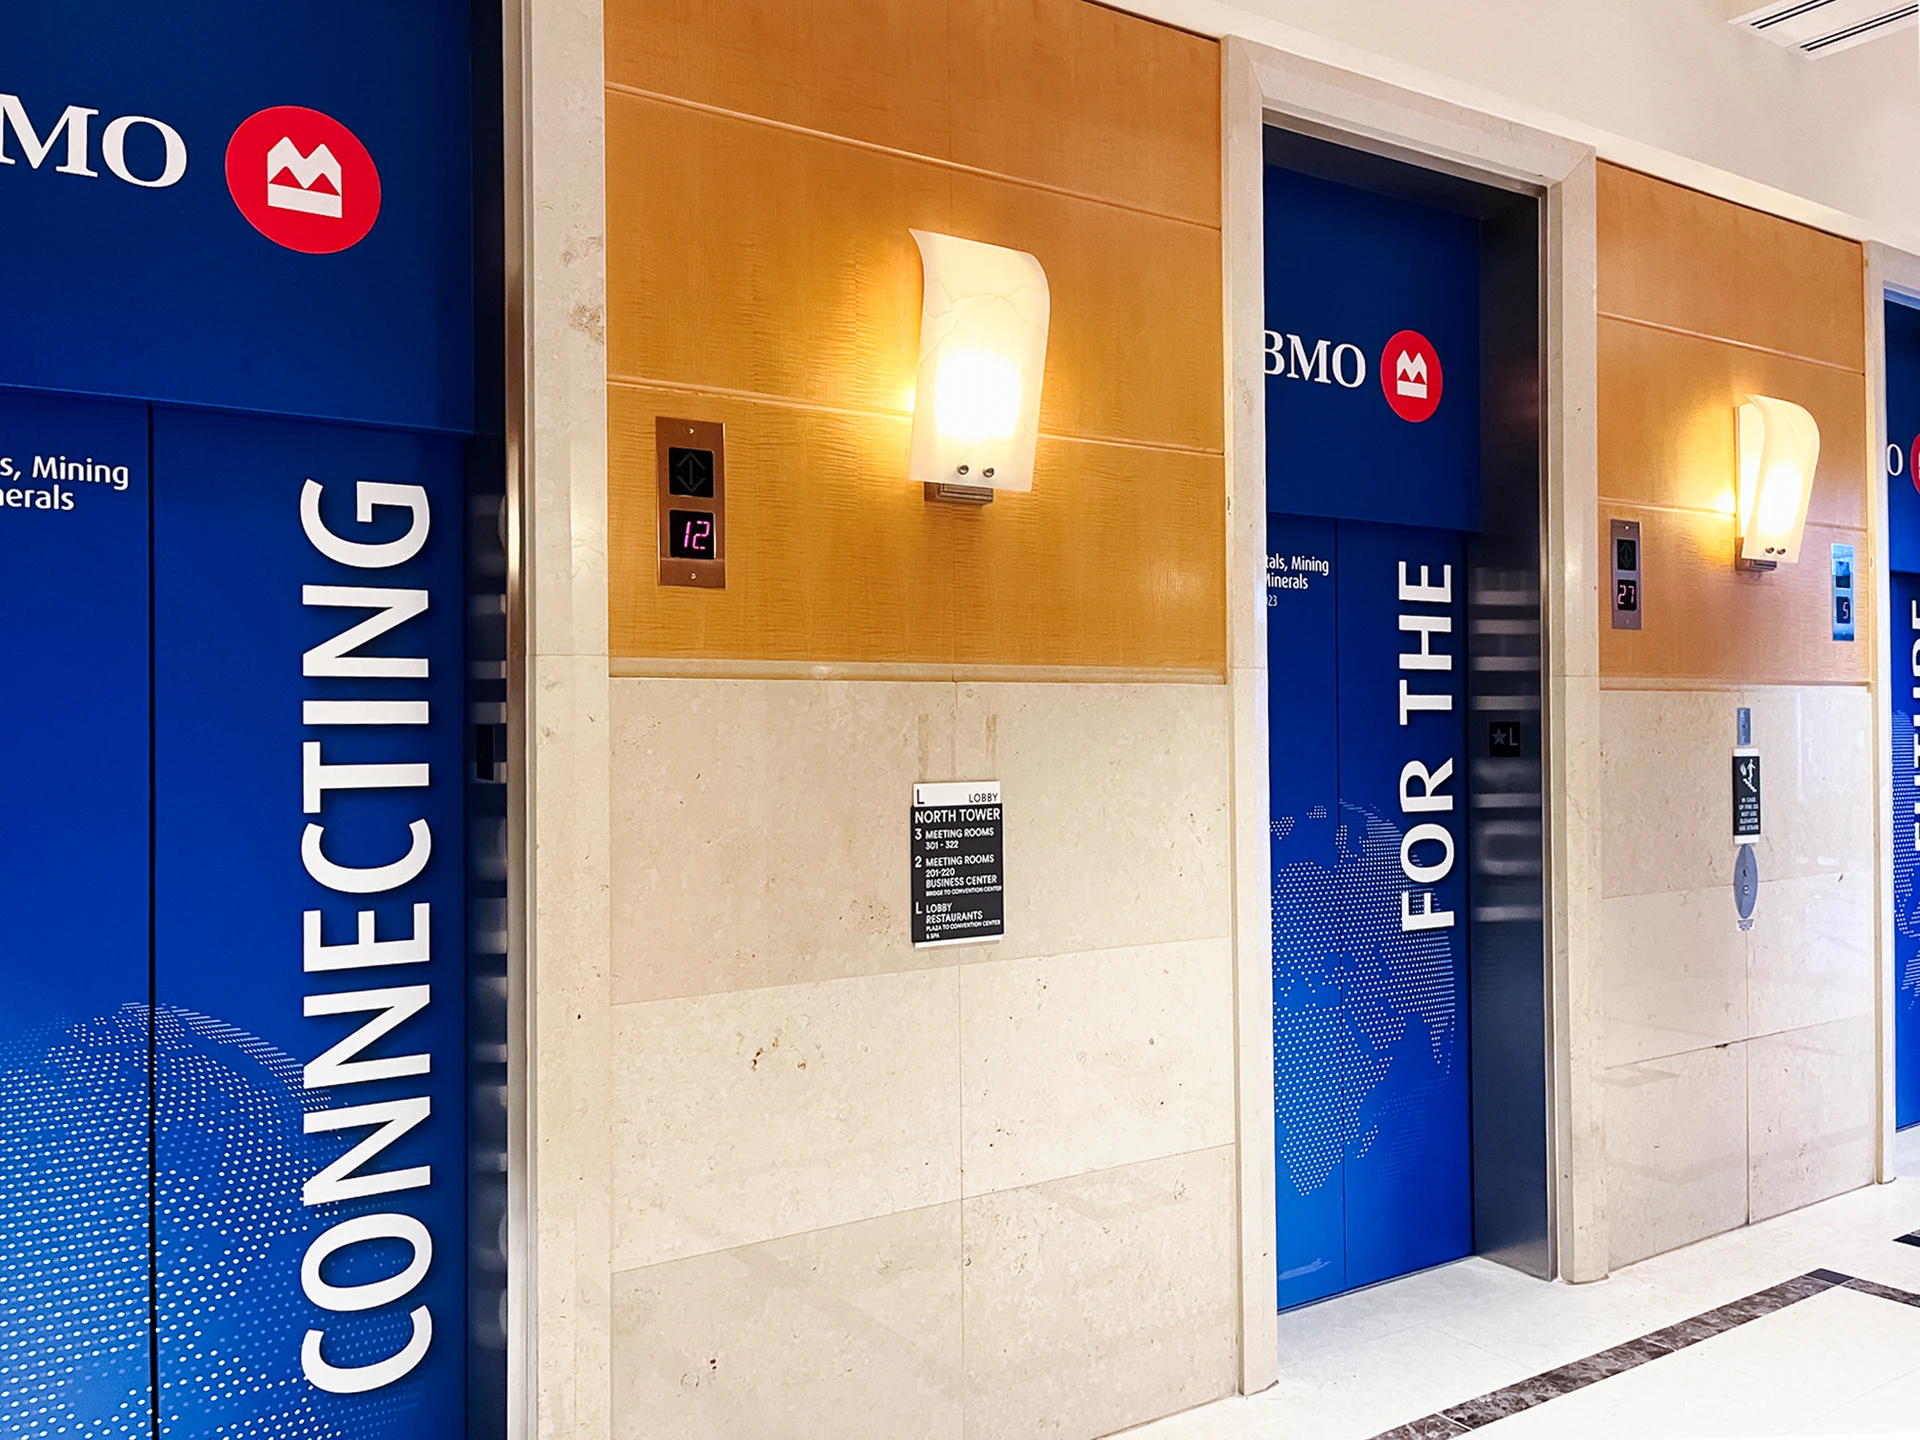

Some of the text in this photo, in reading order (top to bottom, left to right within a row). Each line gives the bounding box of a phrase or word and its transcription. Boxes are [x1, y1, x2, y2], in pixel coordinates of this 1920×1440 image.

[1264, 329, 1366, 388] BMO
[32, 455, 129, 491] Mining
[0, 484, 75, 511] erals
[684, 520, 711, 550] 12
[1291, 555, 1329, 576] Mining
[1617, 584, 1635, 605] 27
[1398, 560, 1455, 932] FOR THE
[916, 789, 998, 805] L LOBBY
[915, 807, 1000, 824] NORTH TOWER
[914, 827, 994, 840] 3 MEETING ROOMS
[925, 841, 939, 850] 301
[945, 840, 959, 849] 322
[914, 854, 994, 868] 2 MEETING ROOMS
[925, 867, 955, 878] 201-220
[926, 875, 997, 889] BUSINESS CENTER
[951, 887, 983, 895] CONVENTION
[983, 885, 1002, 893] CENTER
[915, 901, 953, 915] L LOBBY
[925, 910, 983, 924] RESTAURANTS
[925, 924, 942, 932] PLAZA
[950, 921, 982, 930] CONVENTION
[300, 477, 434, 1395] CONNECTING
